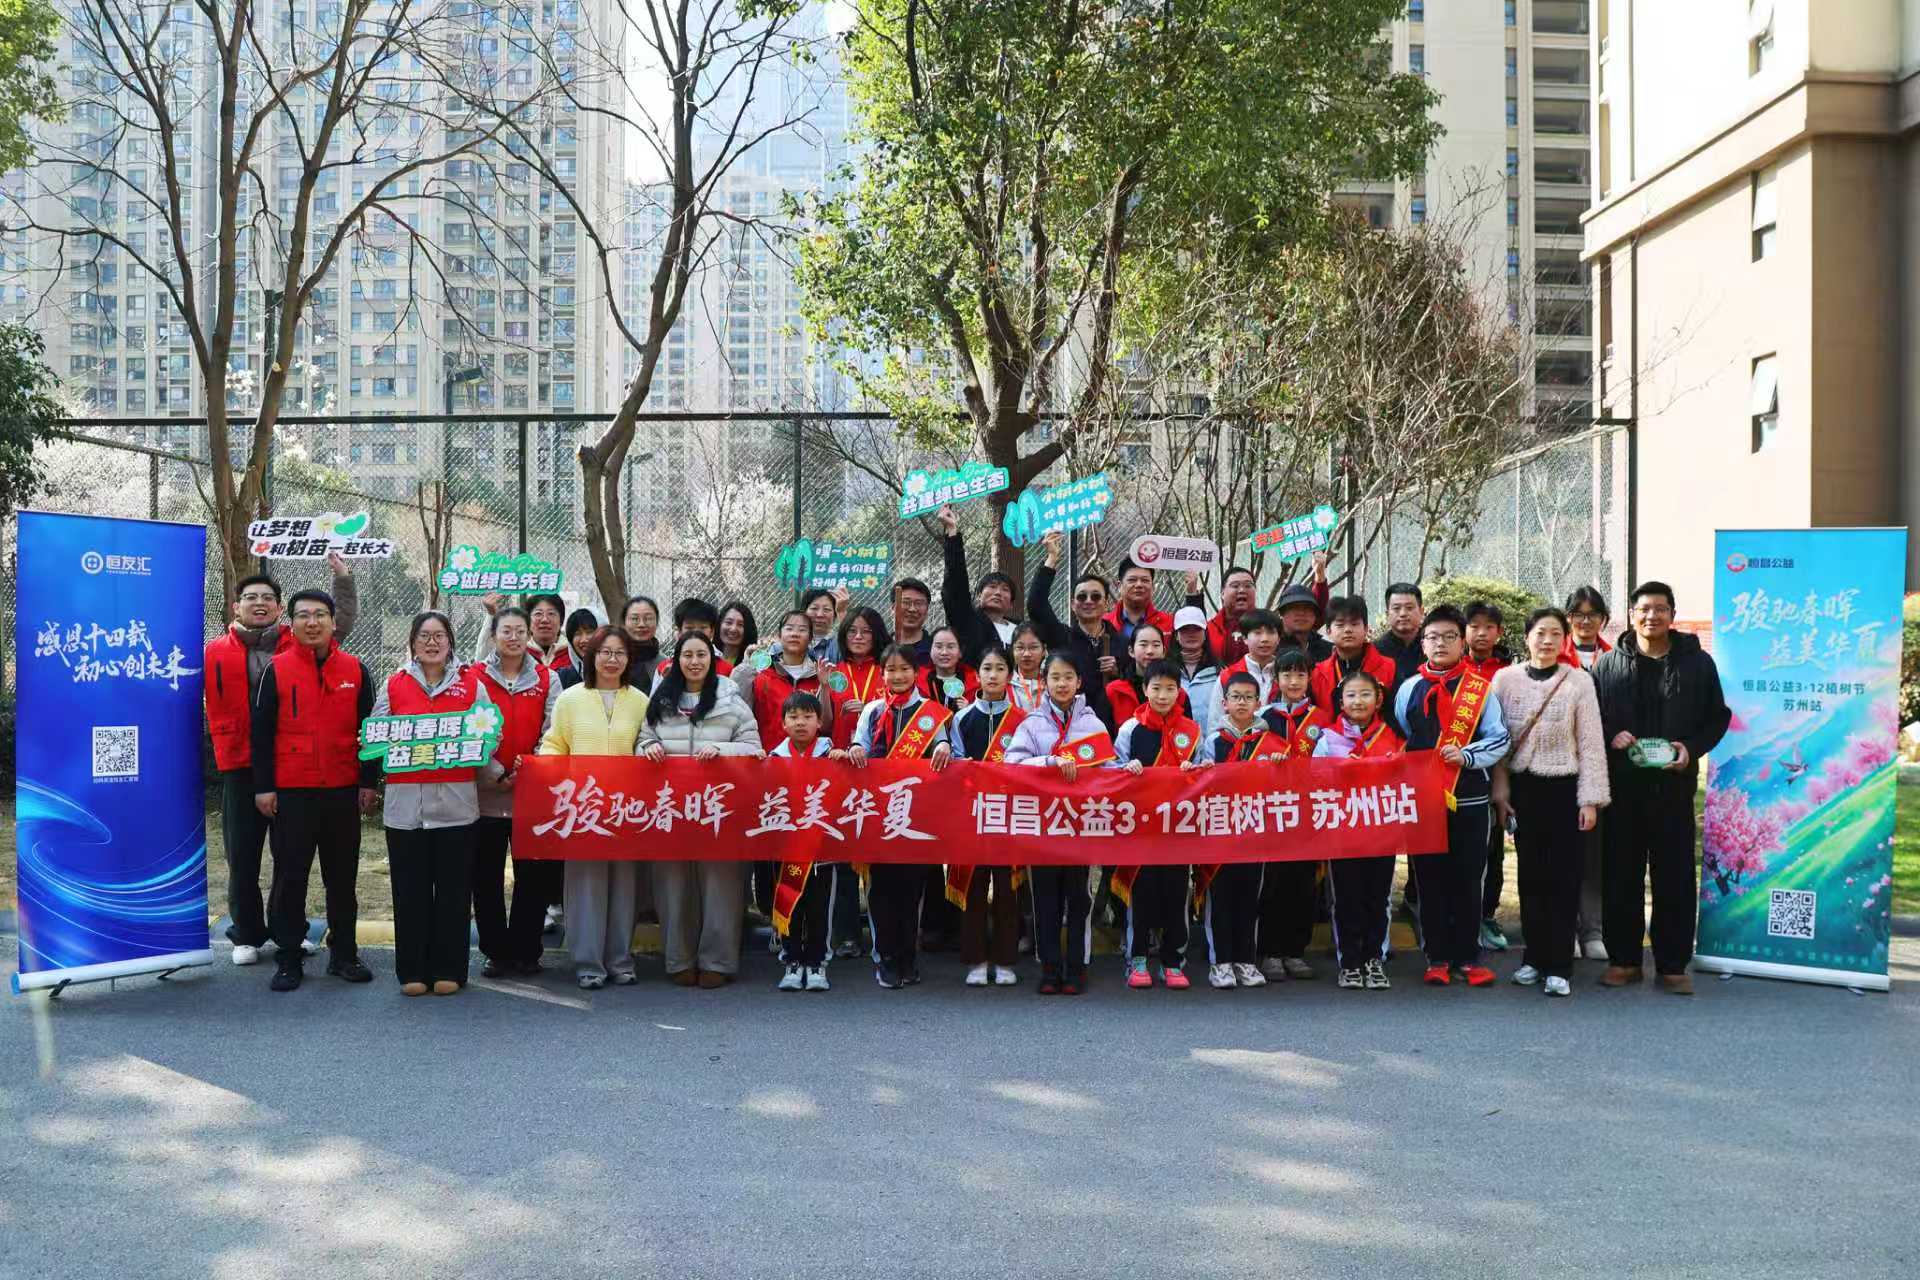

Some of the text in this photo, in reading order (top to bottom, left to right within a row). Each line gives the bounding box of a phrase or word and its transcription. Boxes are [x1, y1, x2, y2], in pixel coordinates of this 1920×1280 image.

[252, 520, 312, 537] 让梦想
[269, 538, 390, 556] 和树苗一起长大
[1161, 547, 1213, 563] 恒昌公益
[106, 555, 152, 571] 恒友汇
[1748, 558, 1795, 569] 恒昌公益
[441, 572, 559, 589] 争做绿色先锋
[1720, 588, 1861, 633] 骏驰春晖
[35, 619, 153, 667] 感恩十四载
[1761, 621, 1884, 672] 益美华夏
[73, 644, 202, 691] 初心创未来
[1743, 679, 1866, 695] 恒昌公益3·12植树节
[1783, 698, 1823, 711] 苏州站
[365, 716, 462, 743] 骏驰春晖
[387, 739, 484, 768] 益美华夏
[532, 775, 1418, 841] 骏驰春晖 益美华夏 恒昌公益3·12植树节 苏州站
